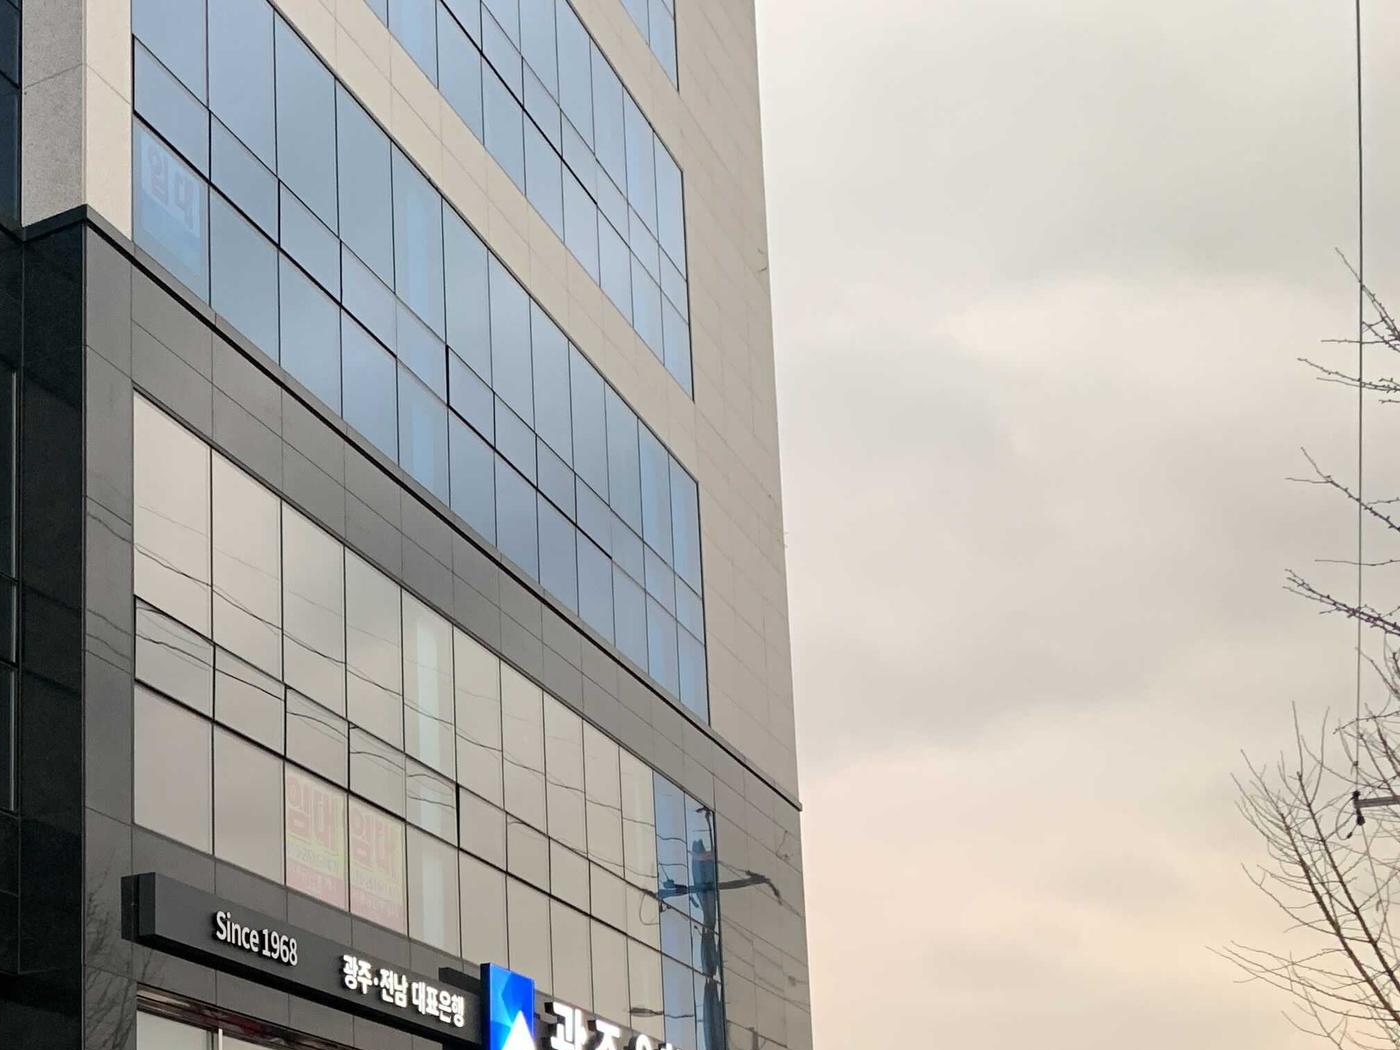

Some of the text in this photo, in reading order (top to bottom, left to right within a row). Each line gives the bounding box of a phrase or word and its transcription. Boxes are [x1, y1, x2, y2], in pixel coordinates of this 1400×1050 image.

[215, 910, 298, 966] Since 1968
[411, 981, 465, 1028] 대표은행
